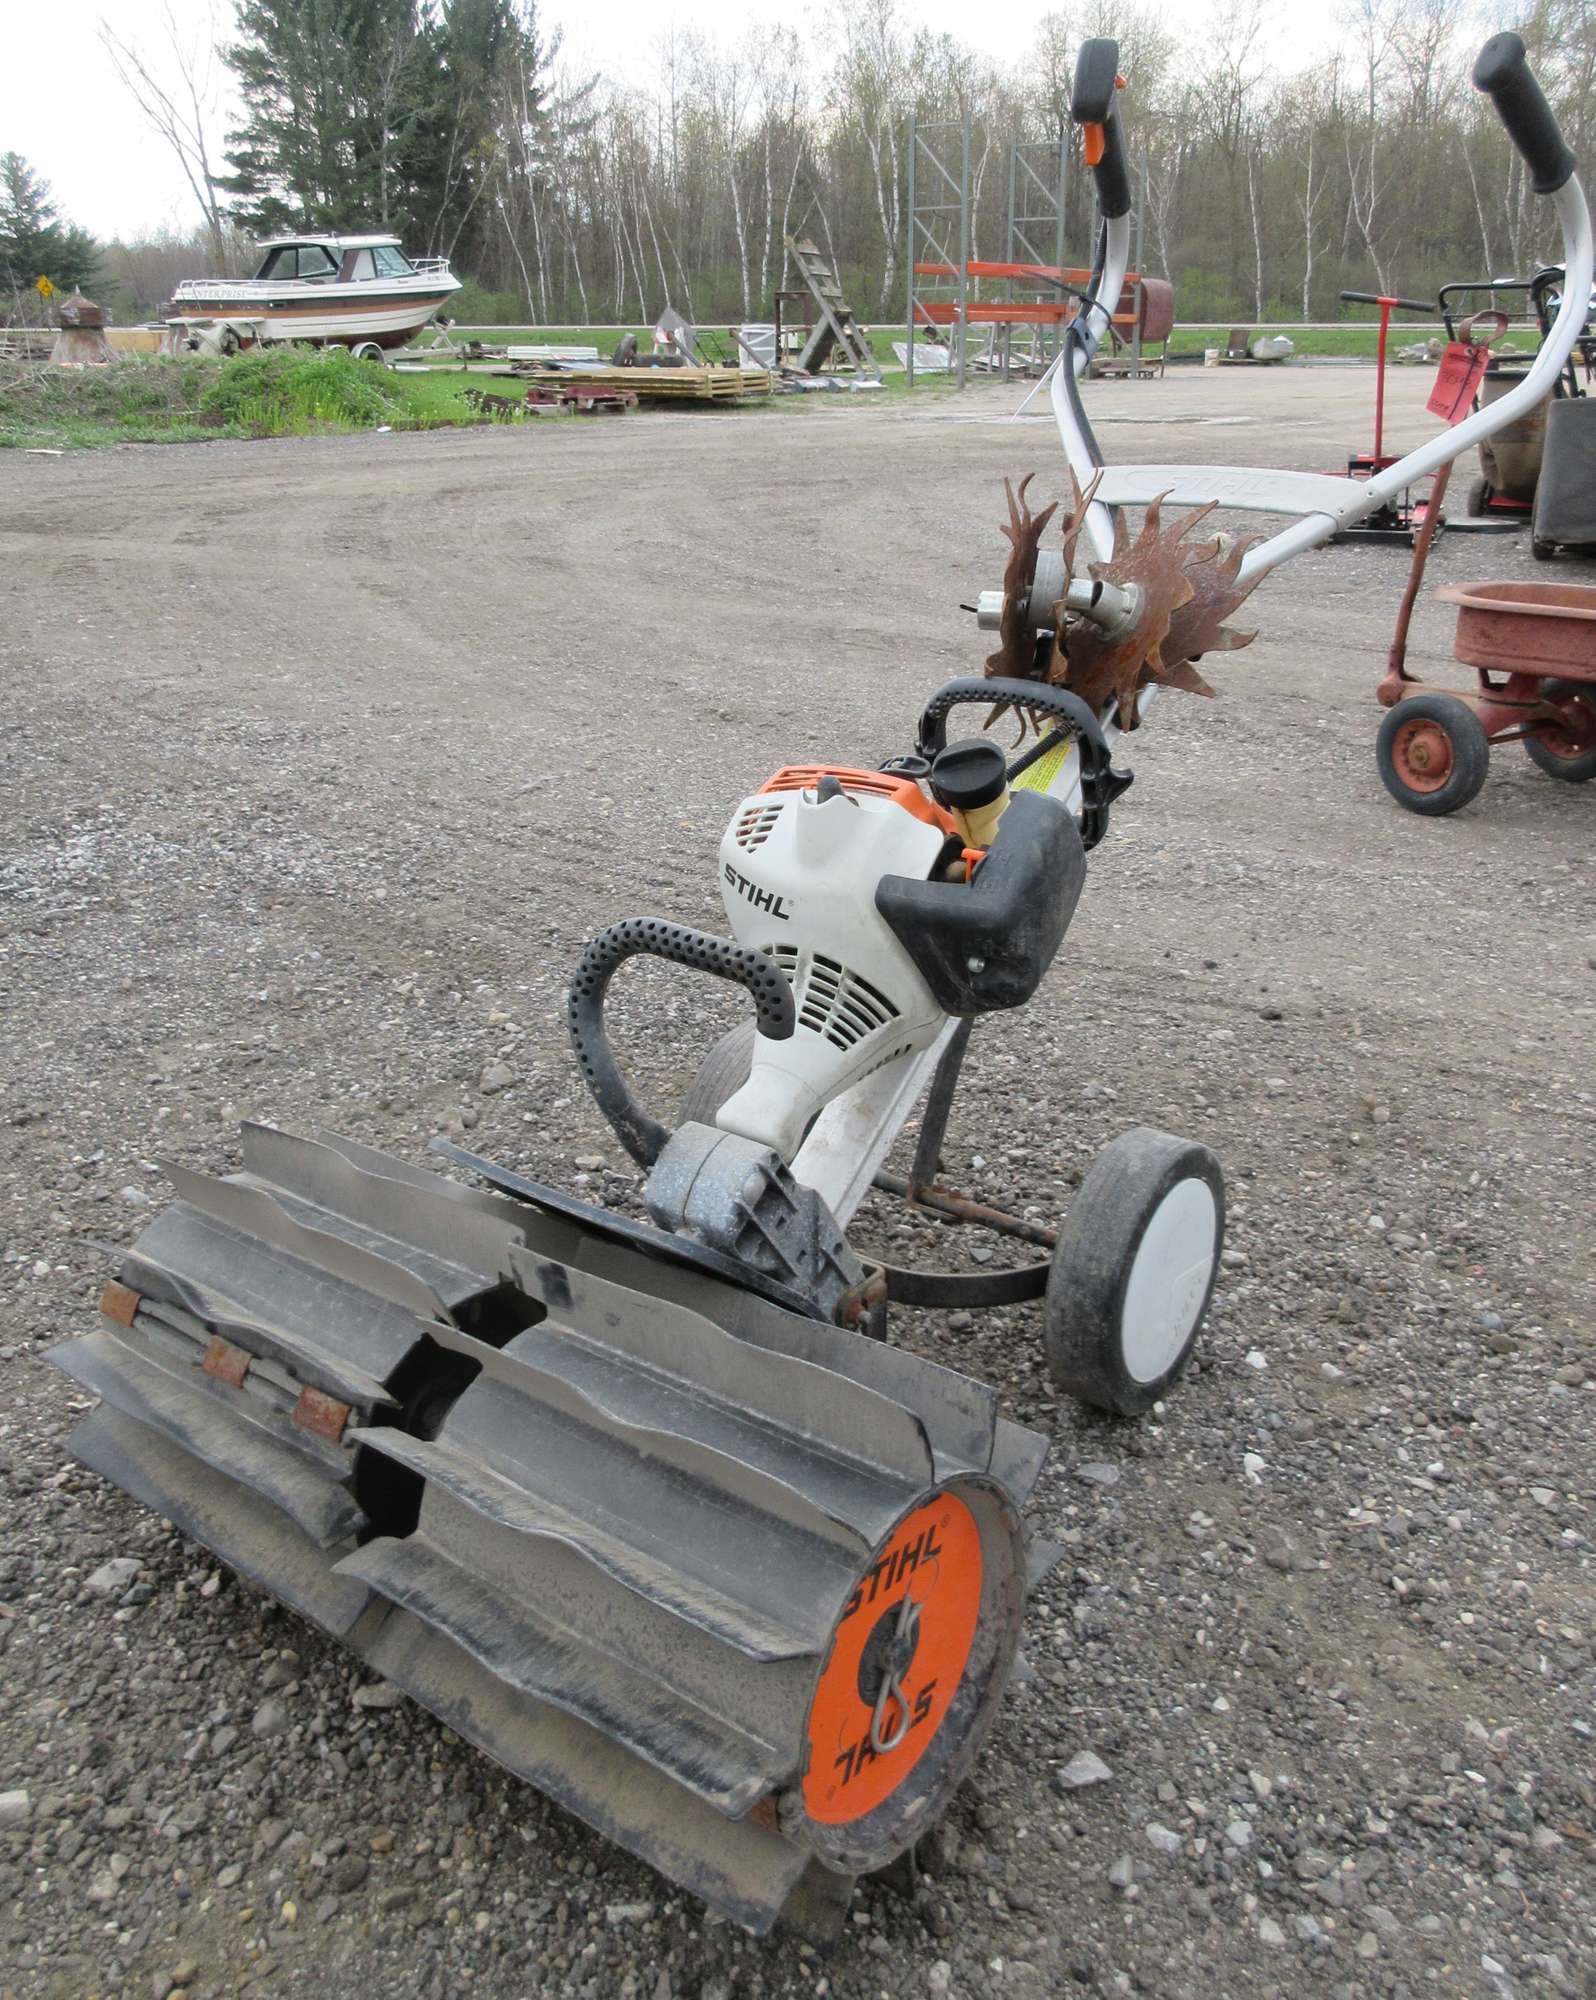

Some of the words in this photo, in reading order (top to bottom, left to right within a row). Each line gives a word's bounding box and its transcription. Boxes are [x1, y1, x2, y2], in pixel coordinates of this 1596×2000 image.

[724, 862, 790, 921] STIHL
[841, 1523, 943, 1620] STIHL
[833, 1677, 938, 1786] SIHL
